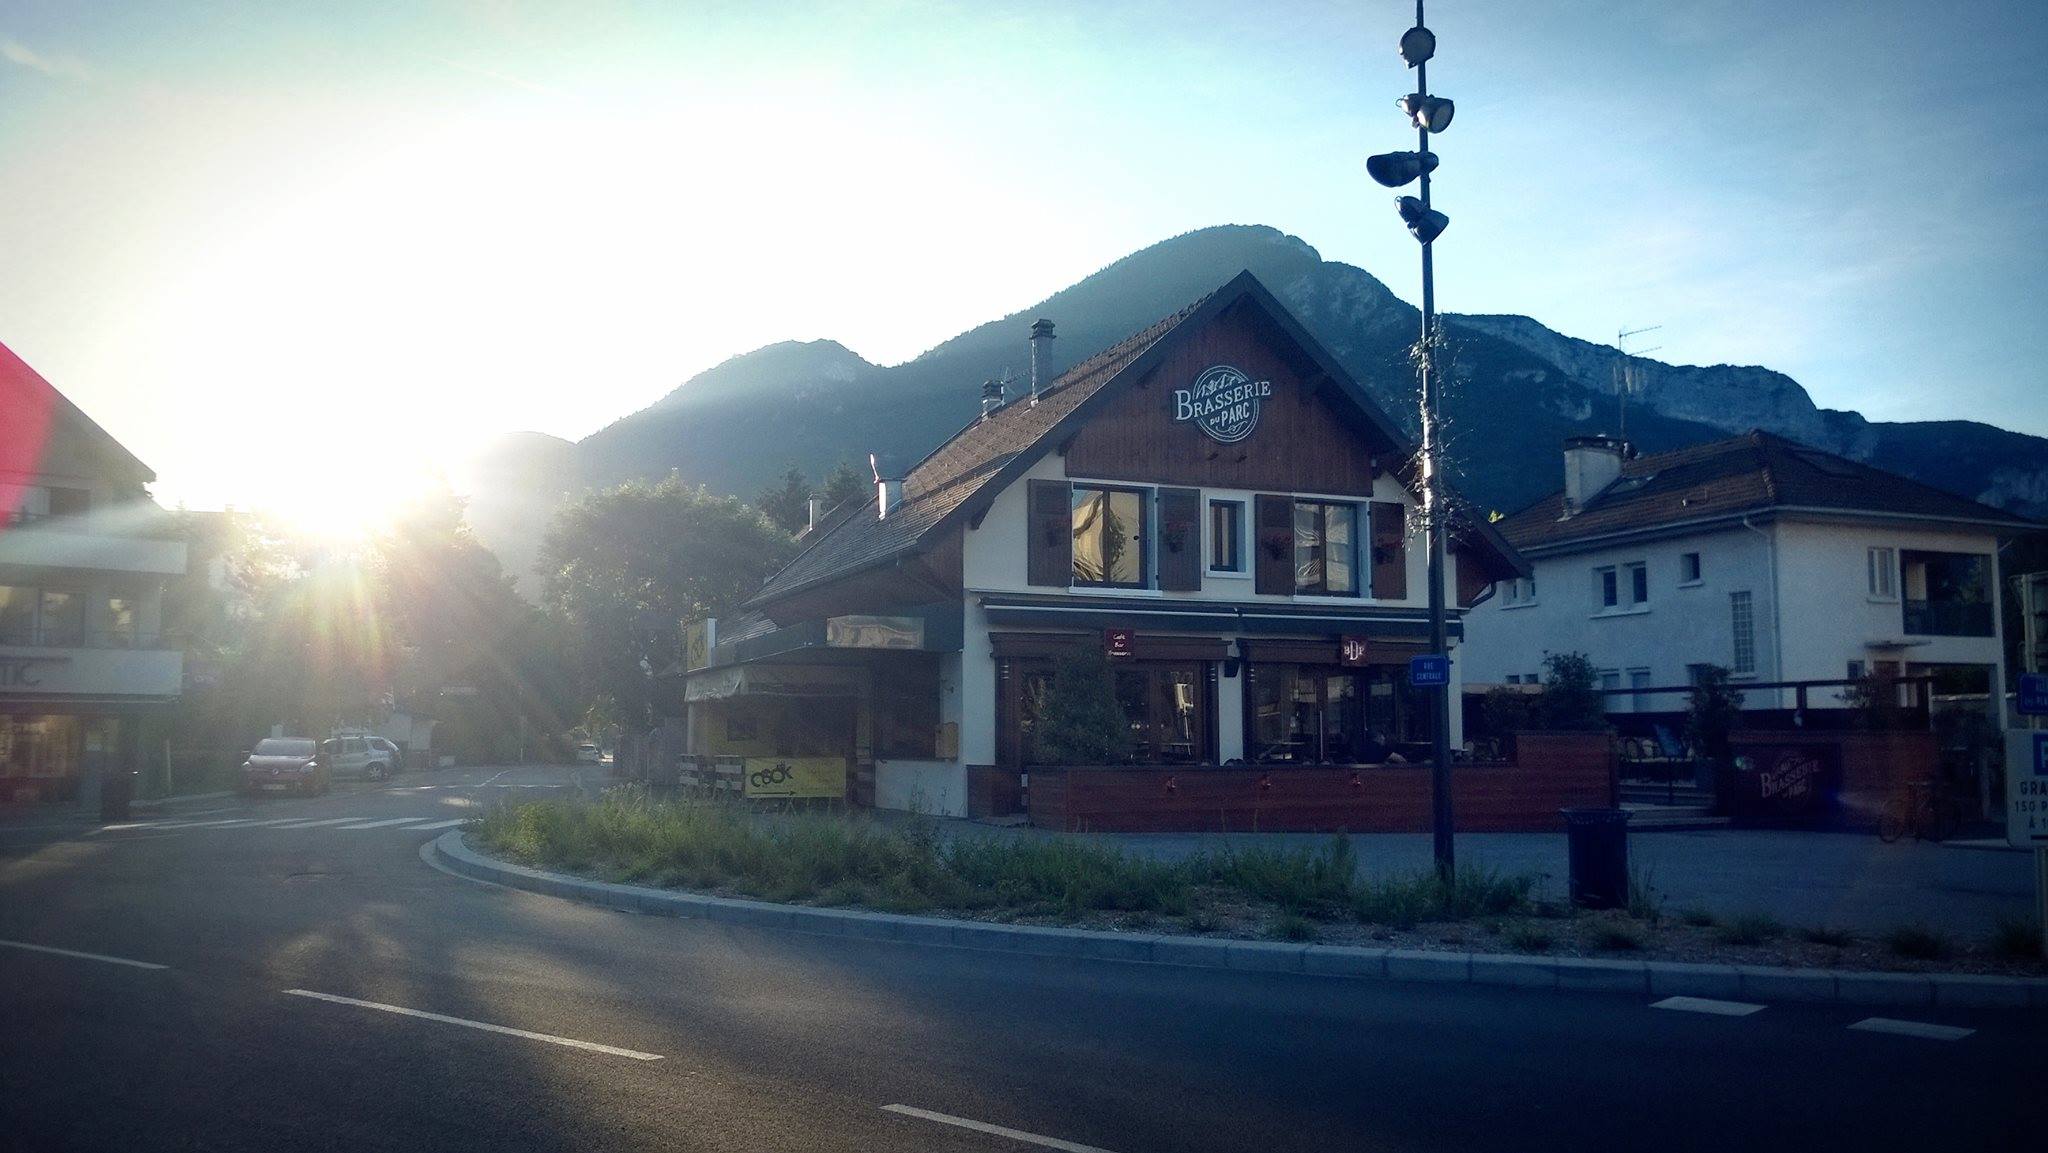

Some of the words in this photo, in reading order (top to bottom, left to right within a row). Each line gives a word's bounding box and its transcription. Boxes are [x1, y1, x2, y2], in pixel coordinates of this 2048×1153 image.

[1175, 381, 1271, 420] BRASSERIE
[1210, 416, 1220, 426] DU
[1221, 402, 1249, 427] PARC
